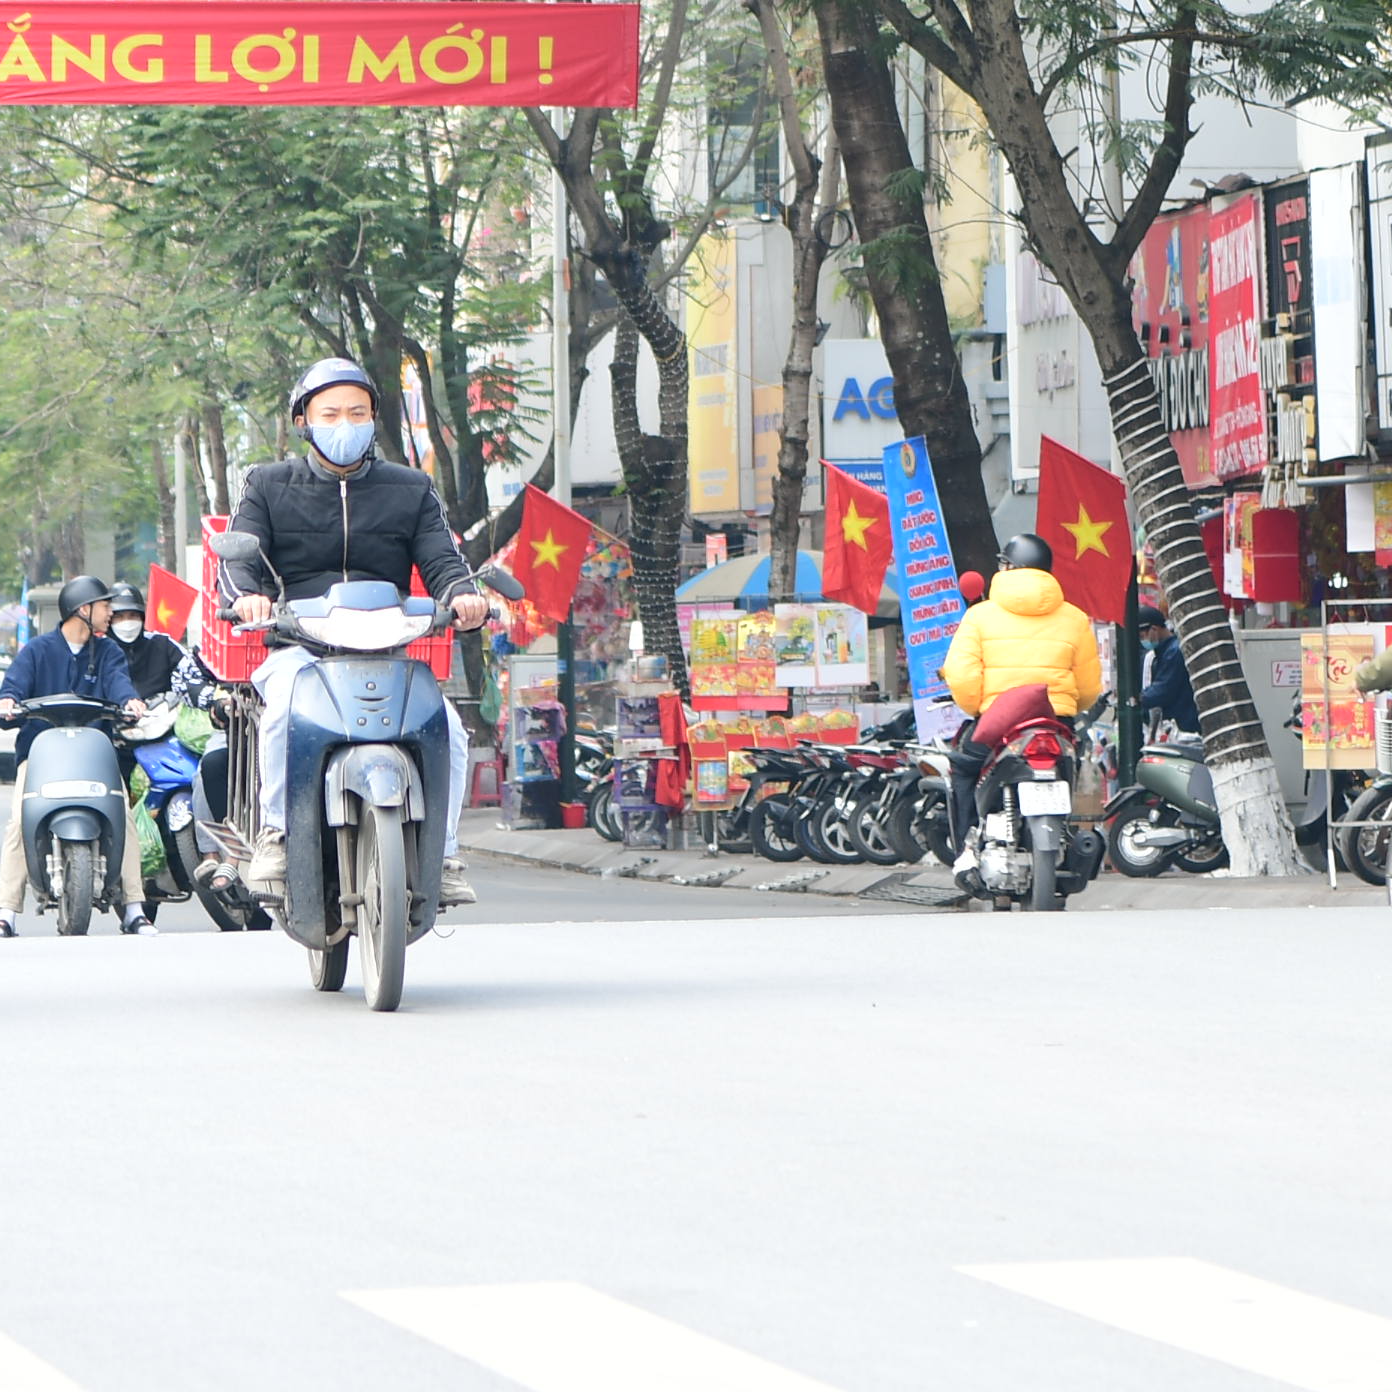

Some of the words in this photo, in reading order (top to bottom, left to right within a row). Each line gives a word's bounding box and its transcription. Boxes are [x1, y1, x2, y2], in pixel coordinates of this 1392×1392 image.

[193, 26, 321, 94] LỢI
[346, 22, 508, 85] MỚI
[537, 35, 554, 86] !
